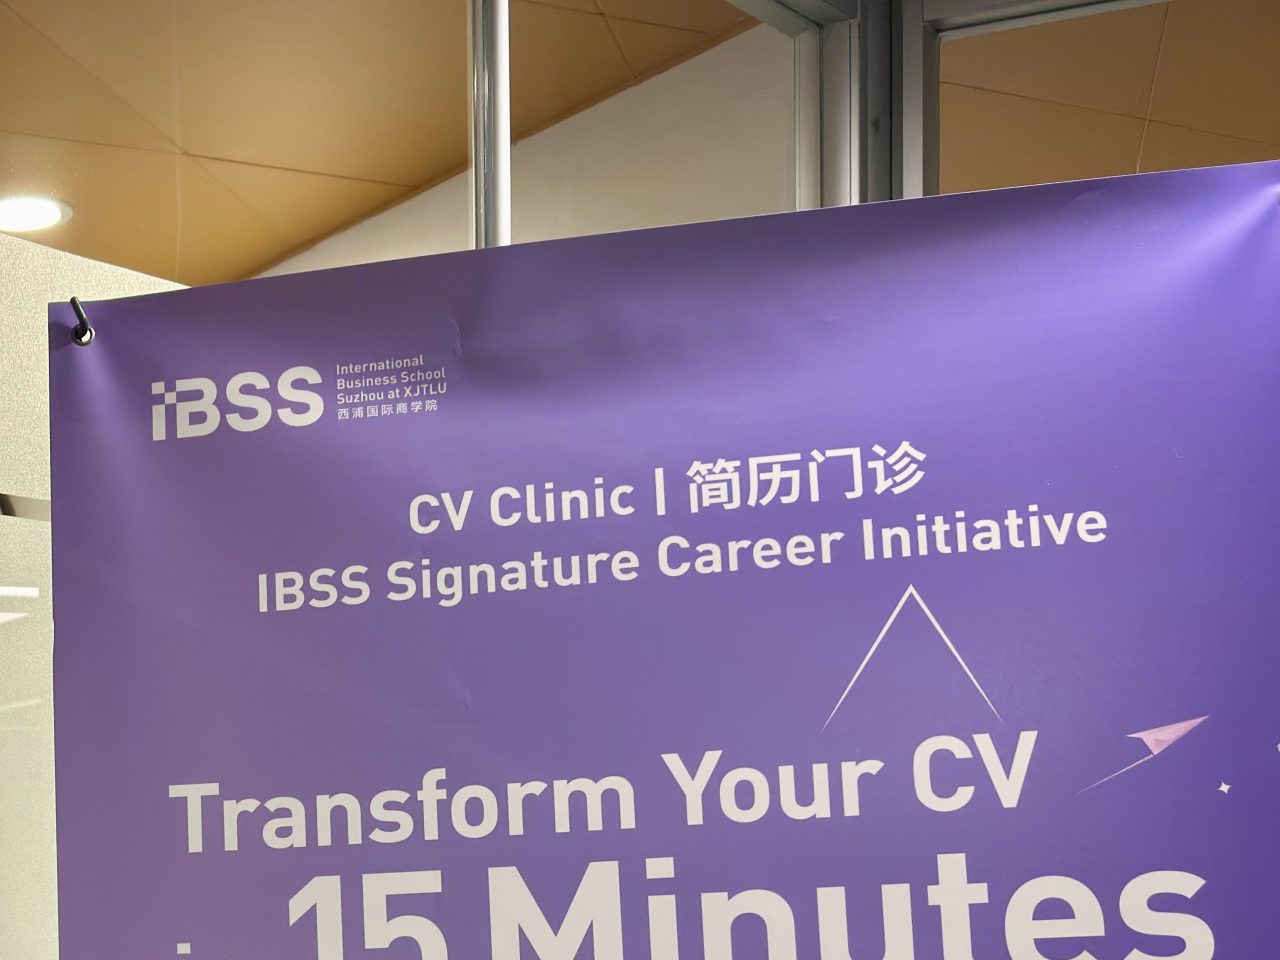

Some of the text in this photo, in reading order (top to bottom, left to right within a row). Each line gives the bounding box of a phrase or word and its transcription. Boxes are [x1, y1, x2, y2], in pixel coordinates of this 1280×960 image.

[336, 354, 424, 375] International
[337, 367, 446, 390] Business School
[337, 382, 447, 405] Suzhou at XJTLU
[337, 399, 438, 420] 西浦国际商学院
[408, 489, 473, 535] CV
[489, 476, 635, 527] Clinic
[687, 442, 926, 512] 简历门诊
[256, 504, 1107, 614] IBSS Signature Career Initiative
[167, 730, 1037, 854] Transform Your CV
